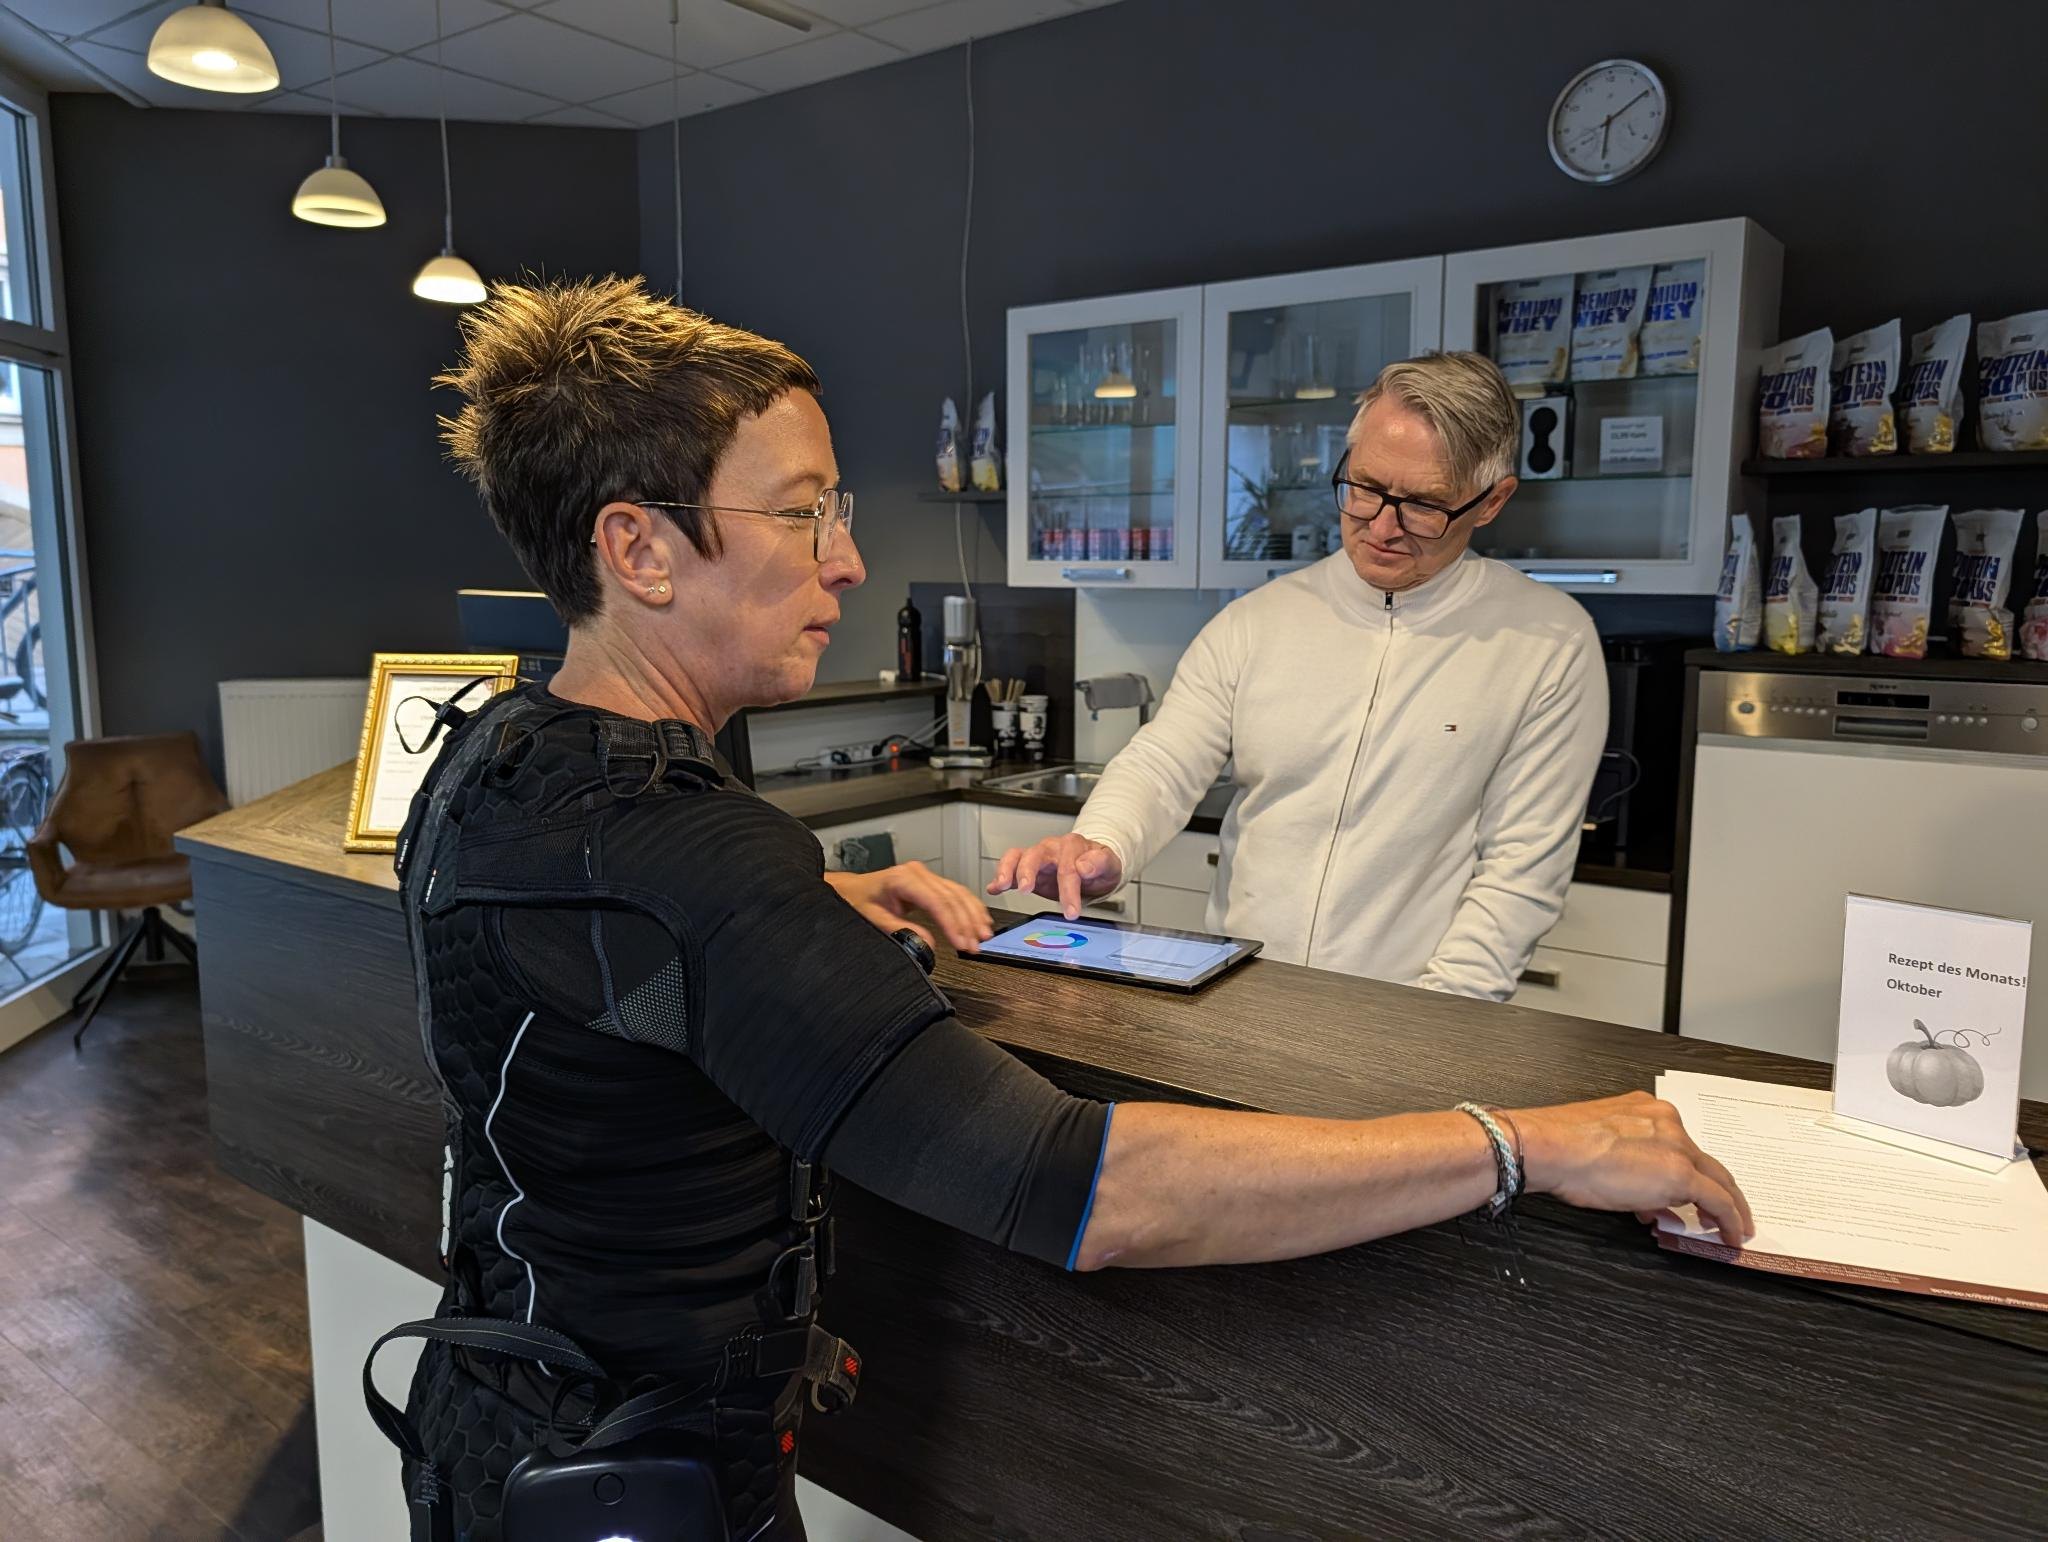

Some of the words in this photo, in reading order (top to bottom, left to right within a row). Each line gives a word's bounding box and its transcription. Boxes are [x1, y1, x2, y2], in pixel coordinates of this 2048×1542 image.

[1645, 300, 1695, 323] HEY
[1888, 953, 1934, 971] Rezept
[1937, 962, 1962, 976] des
[1965, 967, 2027, 988] Monats!
[1886, 978, 1943, 998] Oktober
